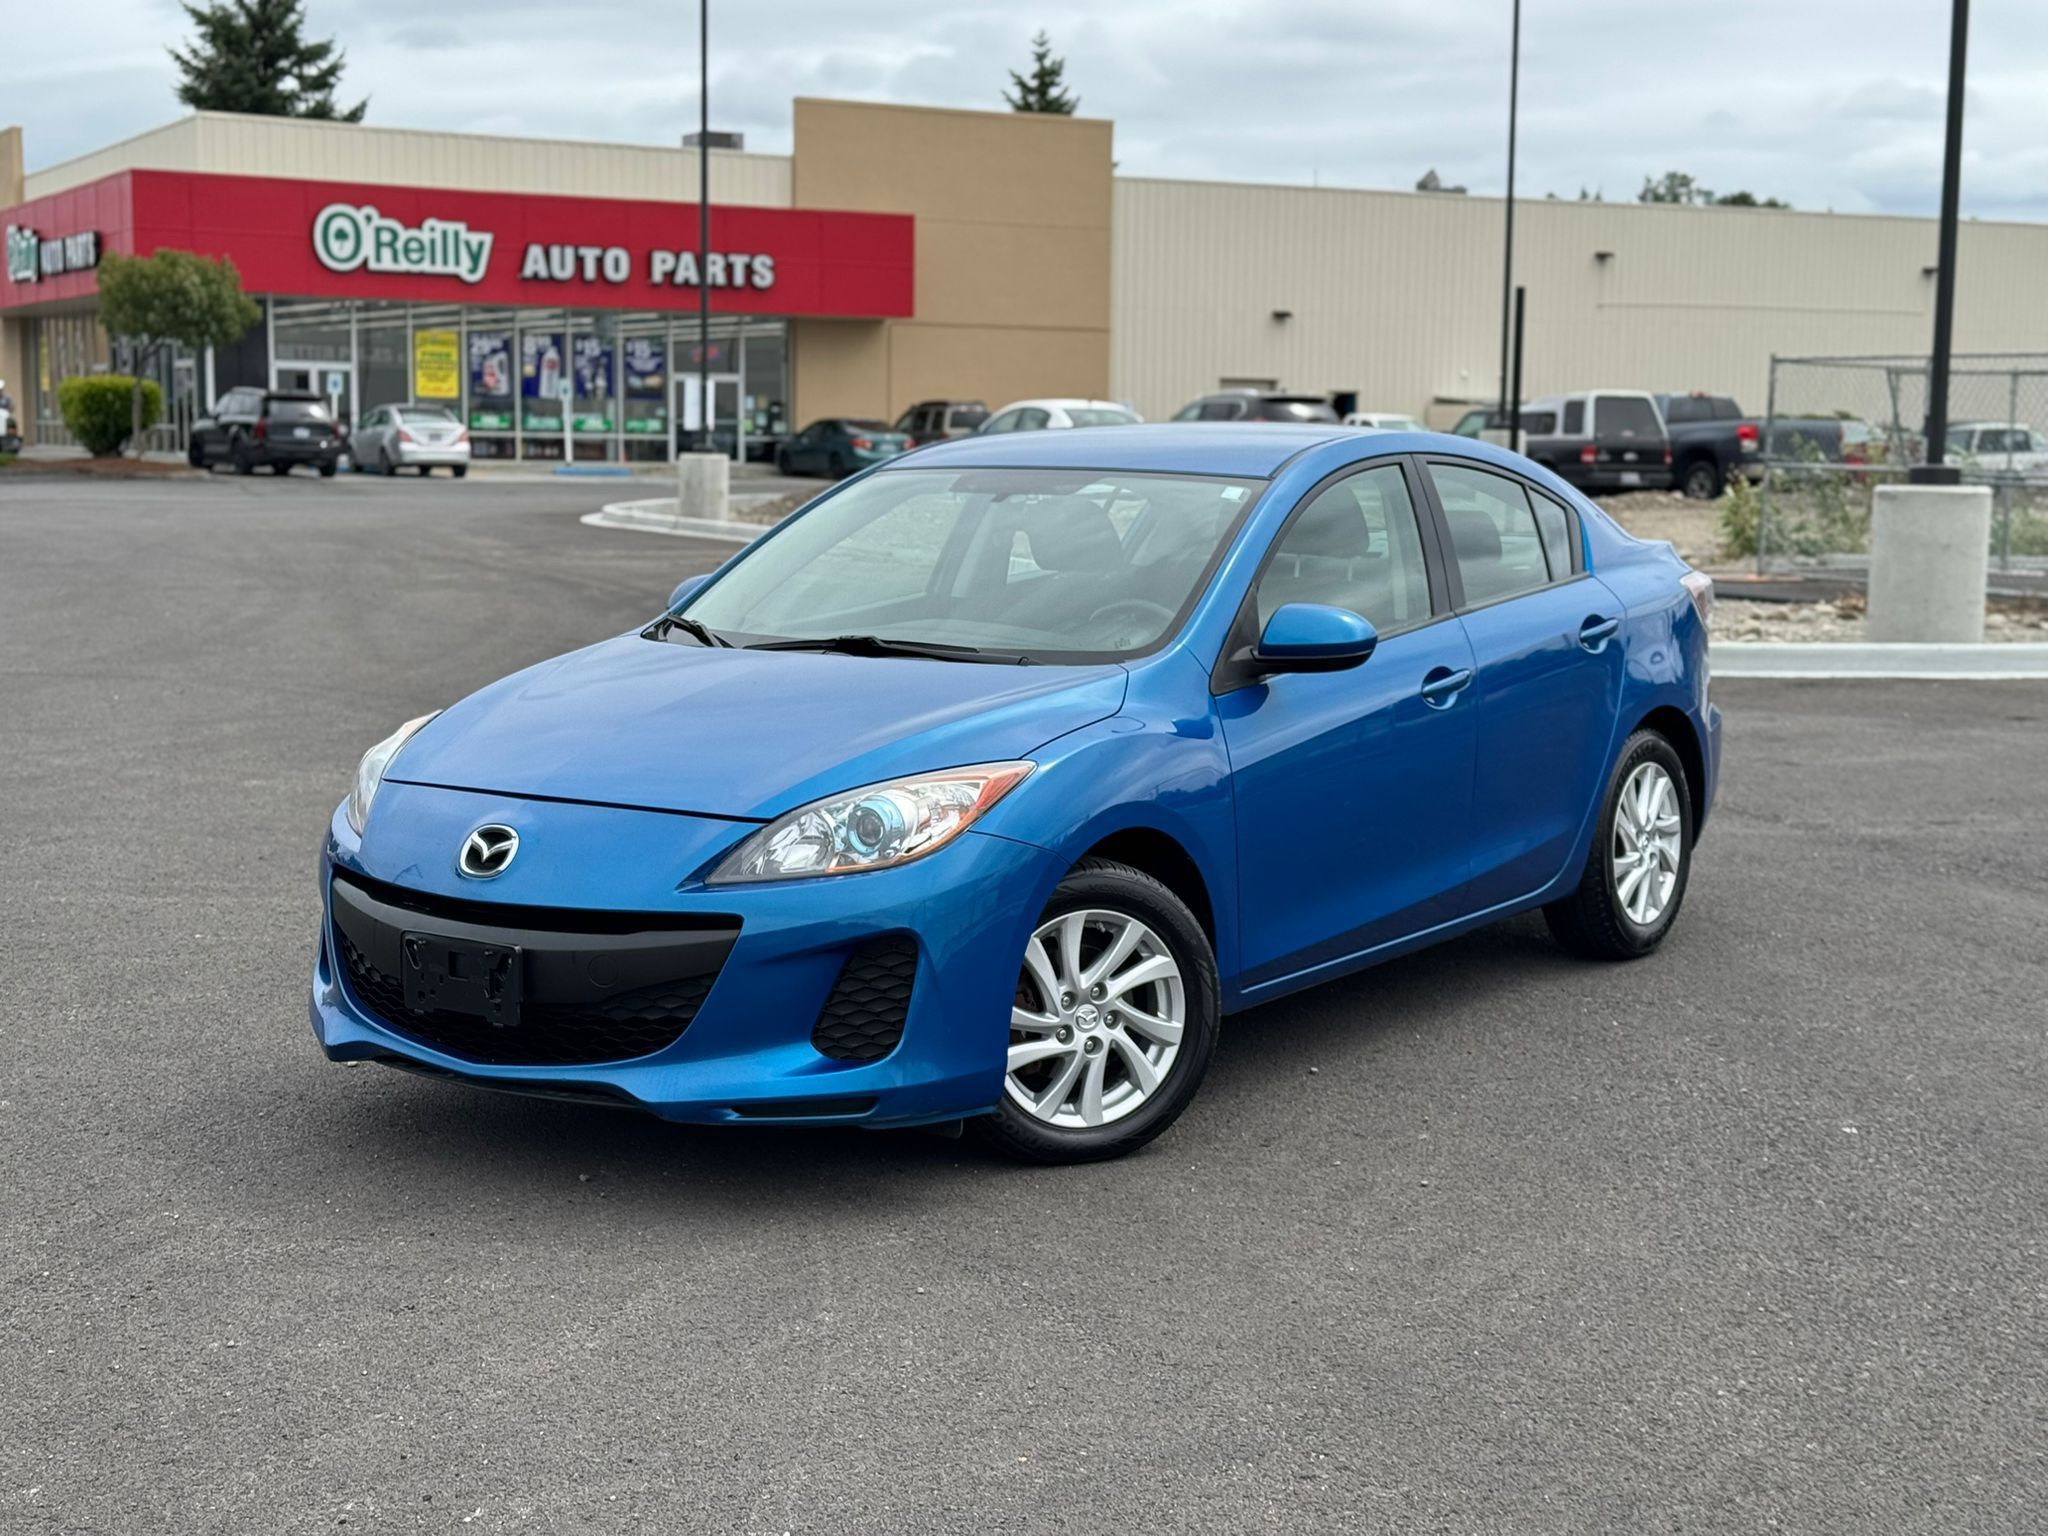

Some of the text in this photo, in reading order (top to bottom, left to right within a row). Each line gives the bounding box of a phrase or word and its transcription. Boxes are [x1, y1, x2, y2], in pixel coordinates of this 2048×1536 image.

[318, 208, 774, 289] O'Reilly AUTO PARTS
